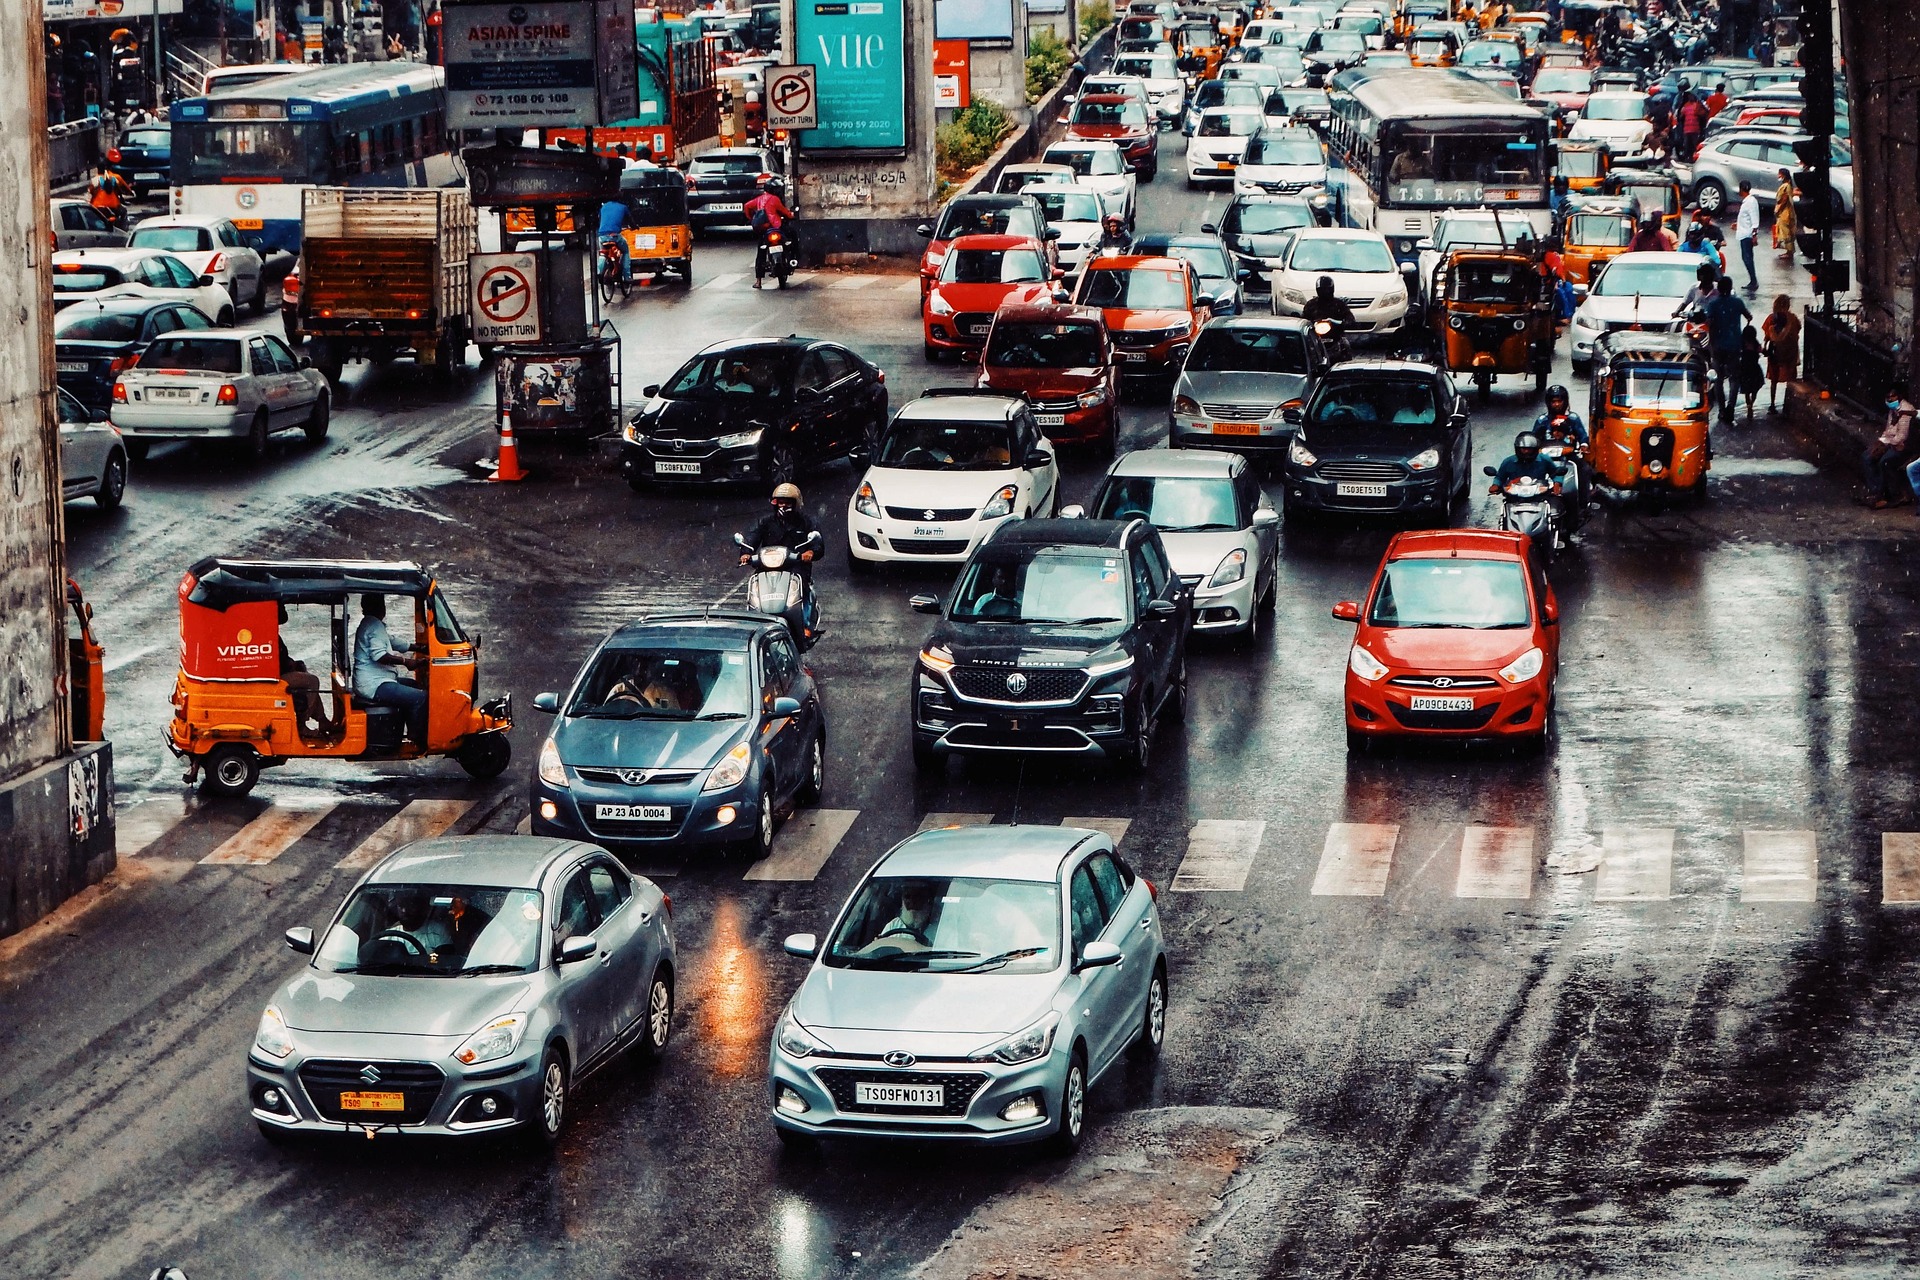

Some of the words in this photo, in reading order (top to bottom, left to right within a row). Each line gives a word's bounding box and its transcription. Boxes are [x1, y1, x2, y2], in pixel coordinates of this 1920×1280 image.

[468, 26, 519, 41] ASIAN
[523, 24, 571, 40] SPINE
[818, 34, 884, 68] vue
[489, 95, 504, 104] 72
[507, 94, 528, 104] 108
[548, 93, 569, 103] 108
[770, 116, 779, 125] NO
[779, 116, 796, 125] RIGHT
[797, 115, 813, 124] TURN
[817, 121, 830, 129] all:
[831, 121, 853, 129] 9090
[868, 120, 890, 128] 2020
[477, 326, 489, 337] NO
[490, 325, 514, 337] RIGHT
[515, 324, 536, 336] TURN
[1342, 485, 1386, 494] TS03ET5151
[217, 644, 272, 656] VIRGO
[1008, 674, 1026, 692] MG
[1413, 698, 1472, 710] AP09CB4433
[601, 807, 613, 817] AP
[615, 808, 626, 817] 23
[628, 808, 641, 818] AD
[643, 809, 665, 818] 0004
[865, 1087, 941, 1103] TS09FN0131
[343, 1099, 361, 1108] TS09
